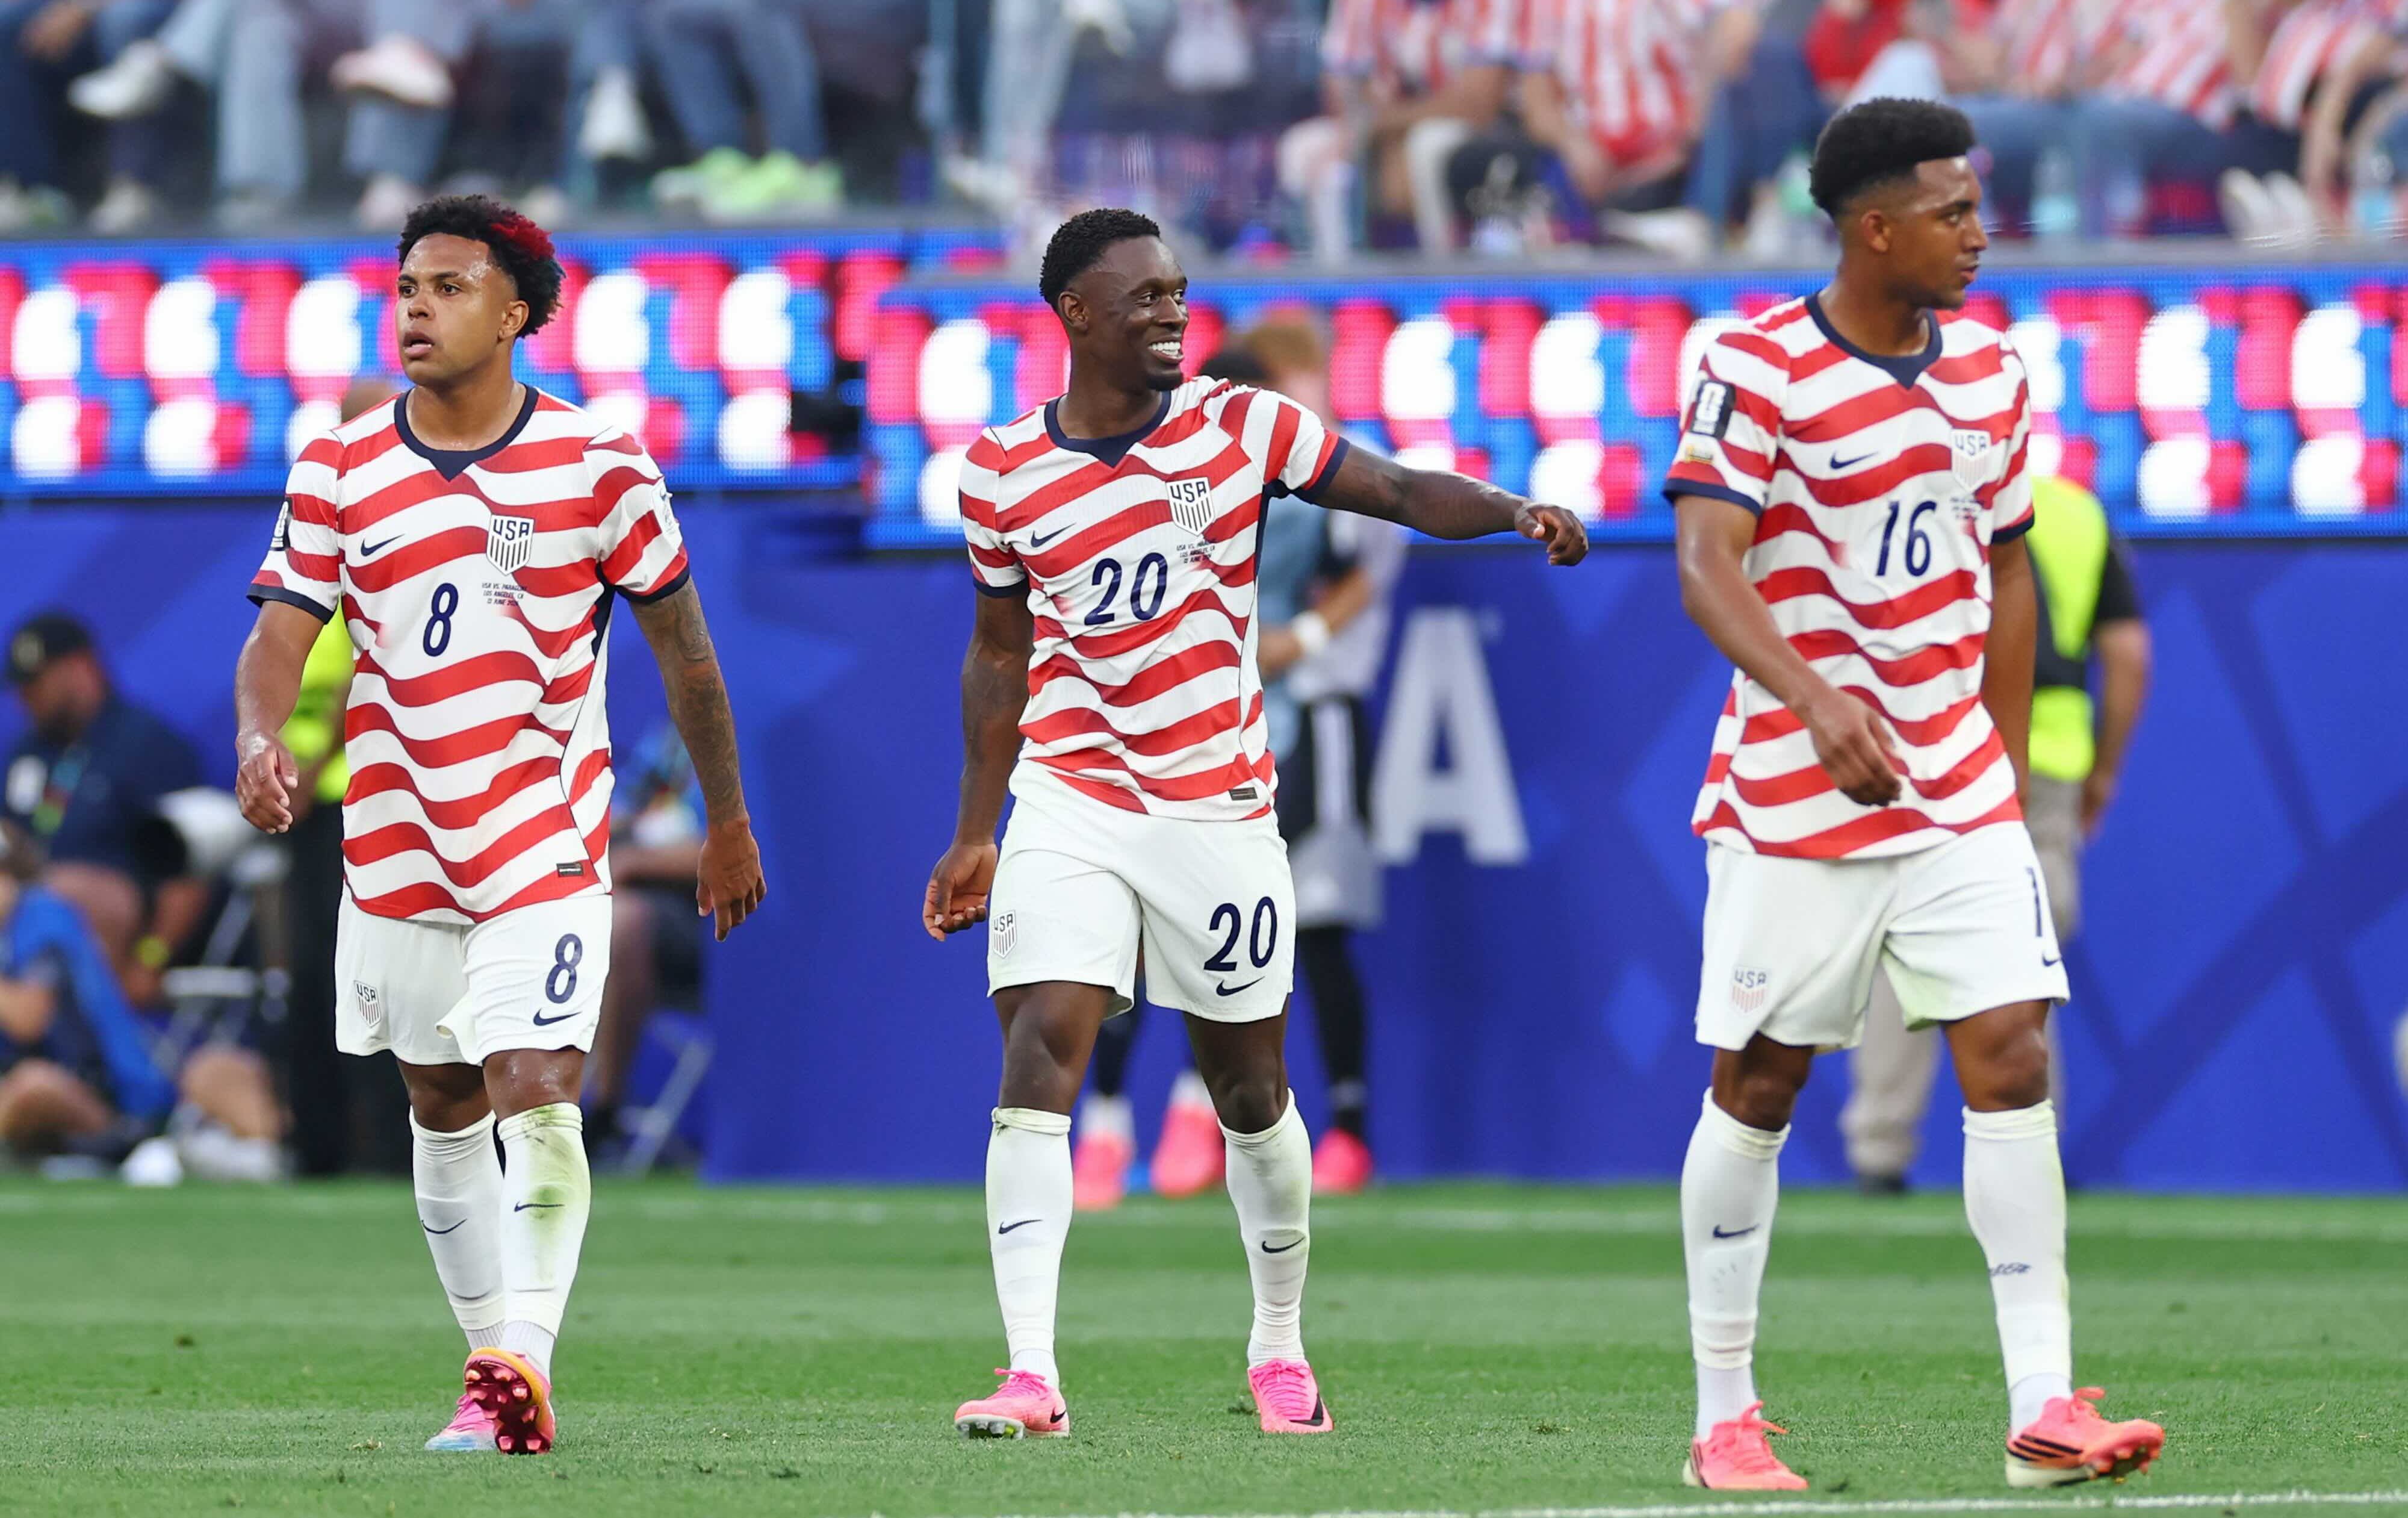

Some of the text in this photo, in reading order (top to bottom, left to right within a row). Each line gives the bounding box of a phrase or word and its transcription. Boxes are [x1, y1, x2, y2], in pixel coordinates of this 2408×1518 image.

[1954, 435, 1987, 456] USA
[1170, 481, 1206, 503] USA
[493, 519, 530, 541] USA
[1875, 500, 1937, 576] 16
[1084, 552, 1167, 625] 20
[423, 582, 458, 657] 8
[993, 913, 1013, 932] USA
[1203, 895, 1277, 971] 20
[545, 933, 583, 1004] 8
[1734, 969, 1767, 989] USA
[356, 983, 376, 1002] USA
